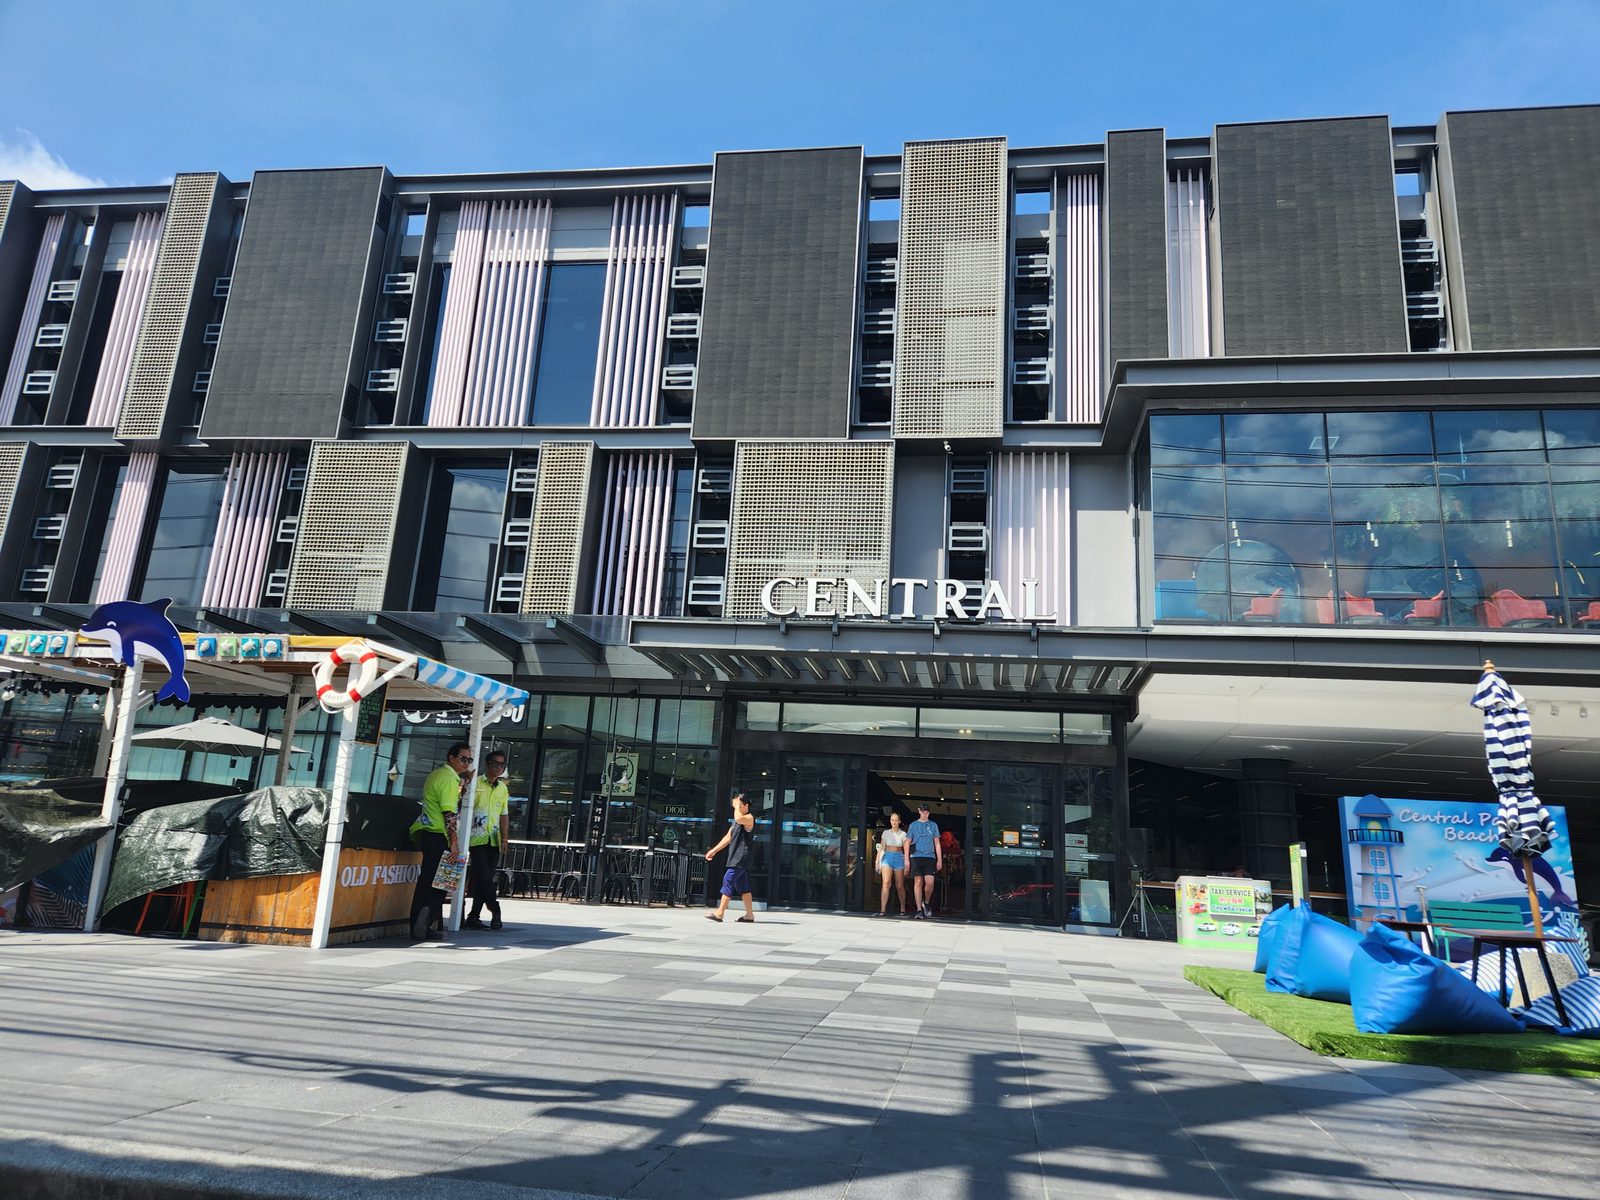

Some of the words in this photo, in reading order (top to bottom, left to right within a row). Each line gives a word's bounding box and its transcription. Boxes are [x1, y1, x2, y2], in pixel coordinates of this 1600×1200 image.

[760, 577, 1058, 622] CENTRAL
[435, 717, 460, 725] Dessert
[665, 805, 686, 814] DIOR
[1400, 809, 1473, 825] Central
[1444, 826, 1498, 843] Beach
[341, 866, 369, 887] OLD
[1225, 889, 1251, 897] SERVICE
